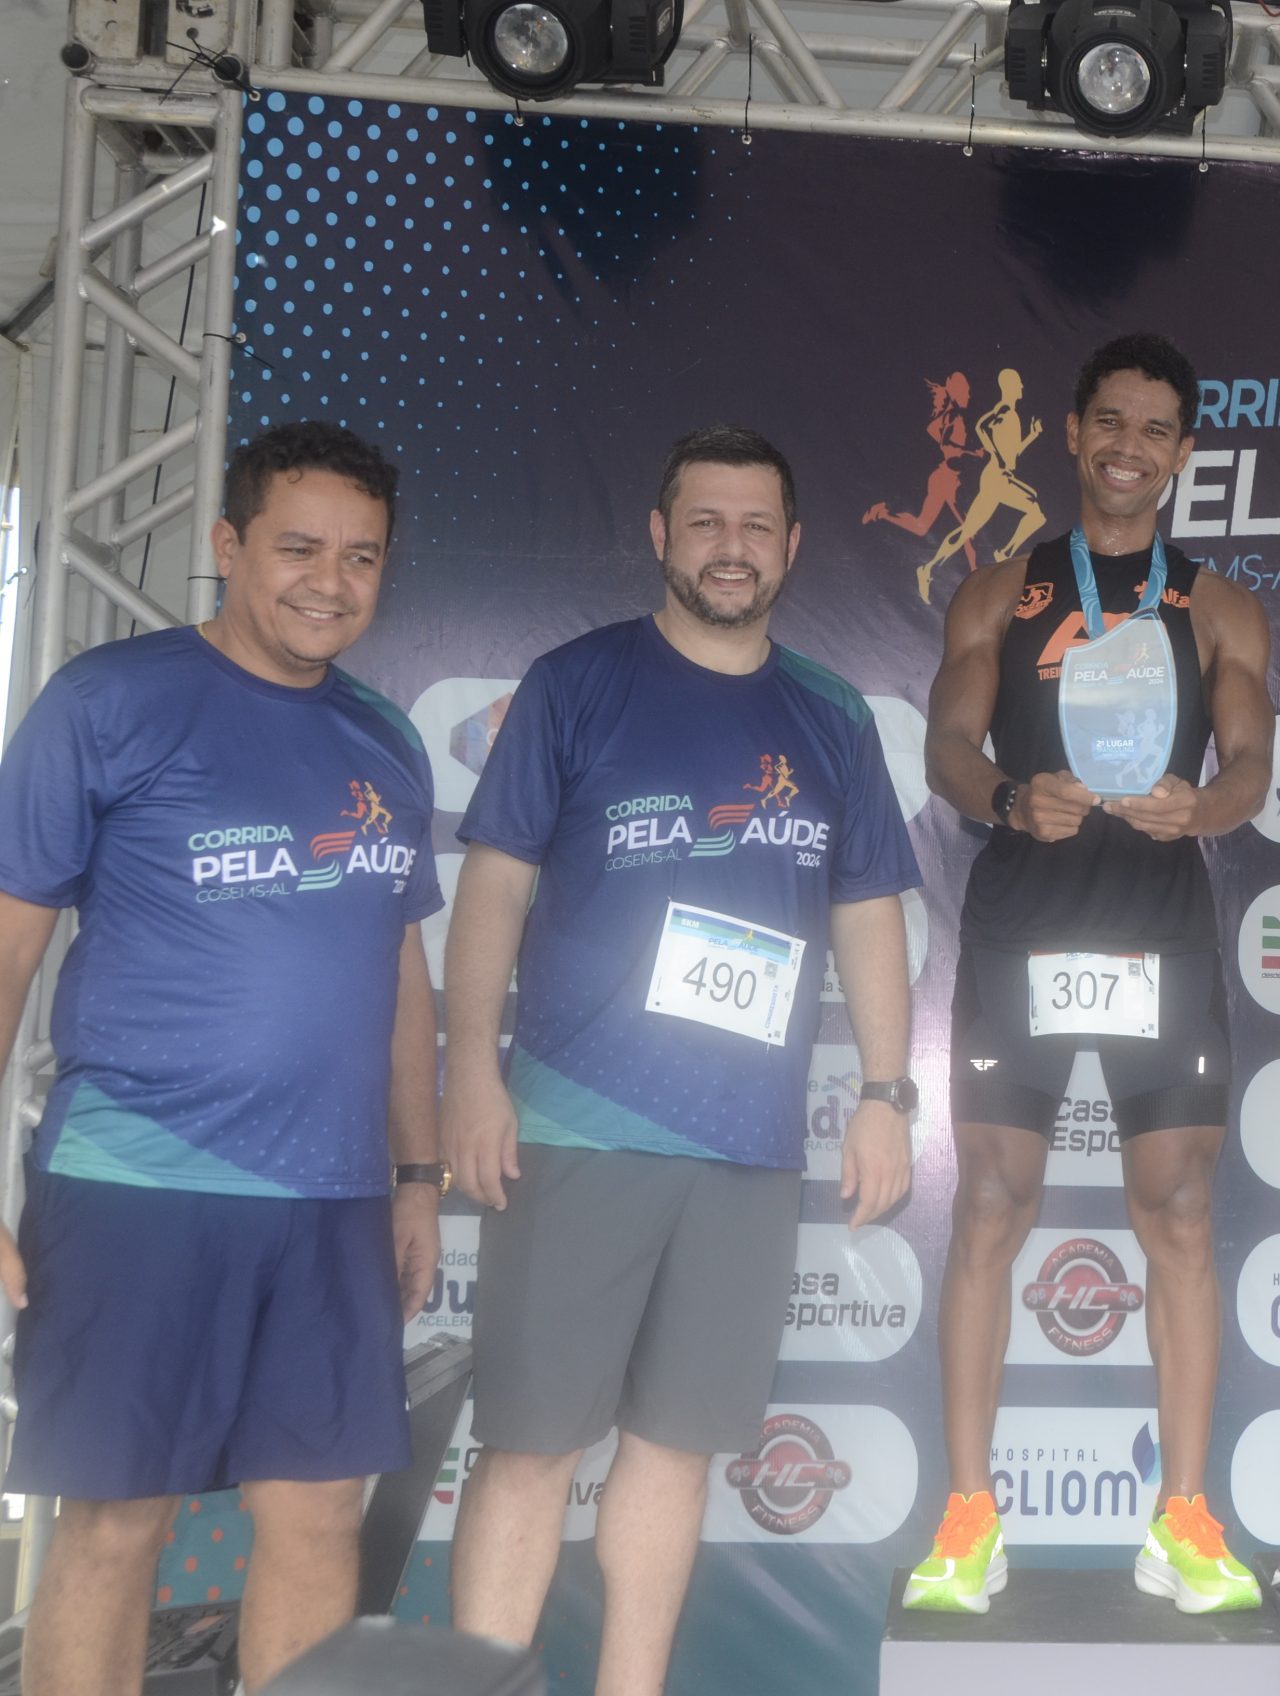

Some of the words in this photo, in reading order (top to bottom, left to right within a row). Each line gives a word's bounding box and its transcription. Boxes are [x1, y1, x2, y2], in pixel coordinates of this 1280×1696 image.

[1073, 670, 1108, 682] PELA
[605, 794, 694, 821] CORRIDA
[188, 825, 294, 851] CORRIDA
[607, 816, 692, 855] PELA
[192, 848, 299, 885] PELA
[605, 848, 683, 872] COSEMS-AL
[796, 852, 821, 868] 2024
[682, 957, 757, 1010] 490
[1052, 971, 1120, 1010] 307
[1052, 1243, 1114, 1267] ACADEMIA
[1048, 1326, 1112, 1350] FITNESS
[990, 1448, 1099, 1462] HOSPITAL
[751, 1504, 820, 1528] FITNESS
